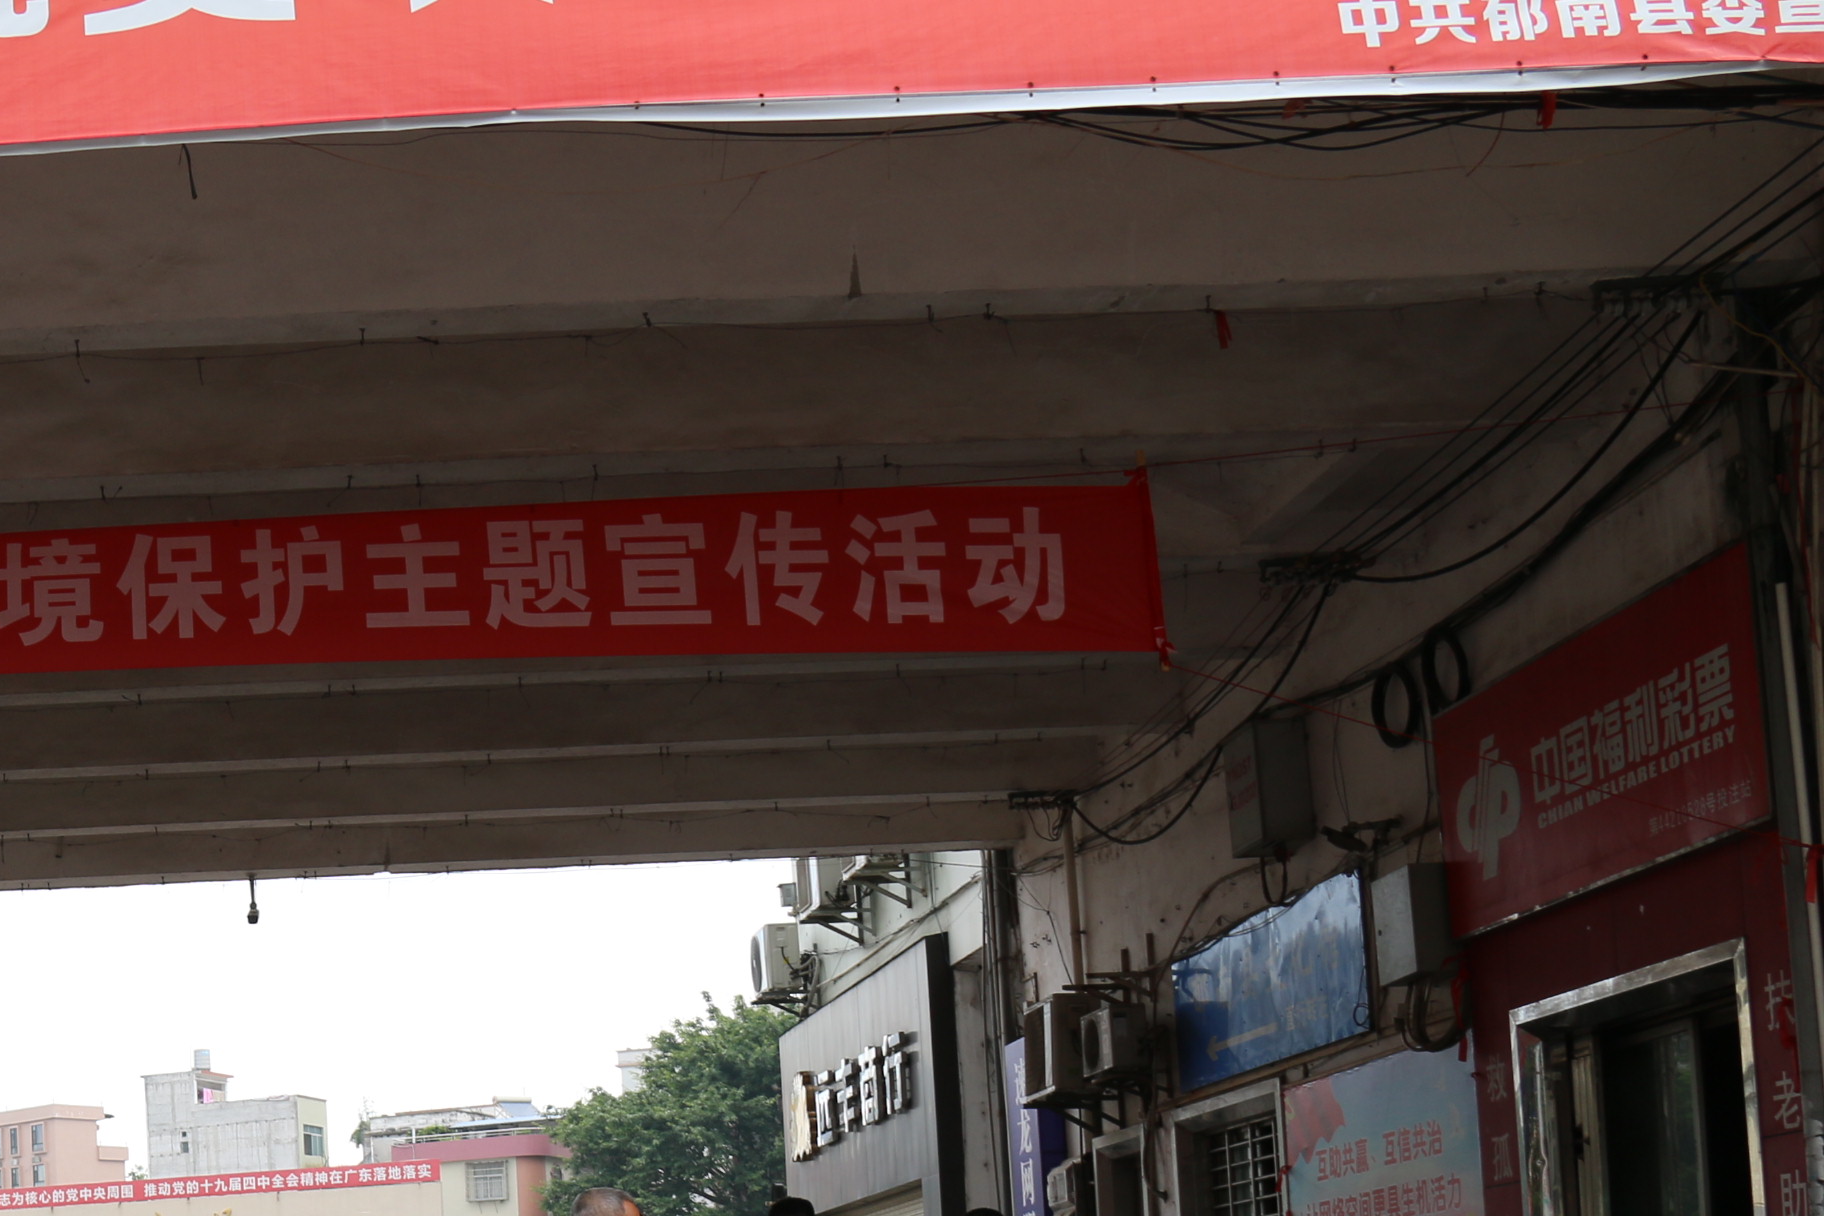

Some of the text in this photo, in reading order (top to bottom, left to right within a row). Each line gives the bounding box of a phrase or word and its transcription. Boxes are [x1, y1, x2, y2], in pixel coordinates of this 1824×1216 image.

[1530, 642, 1735, 805] 中国福利彩票
[1537, 724, 1737, 829] CHIAN WELFARE LOTTERY
[143, 1164, 432, 1198] 推动党的十九届四中全会精神在广东落地落实
